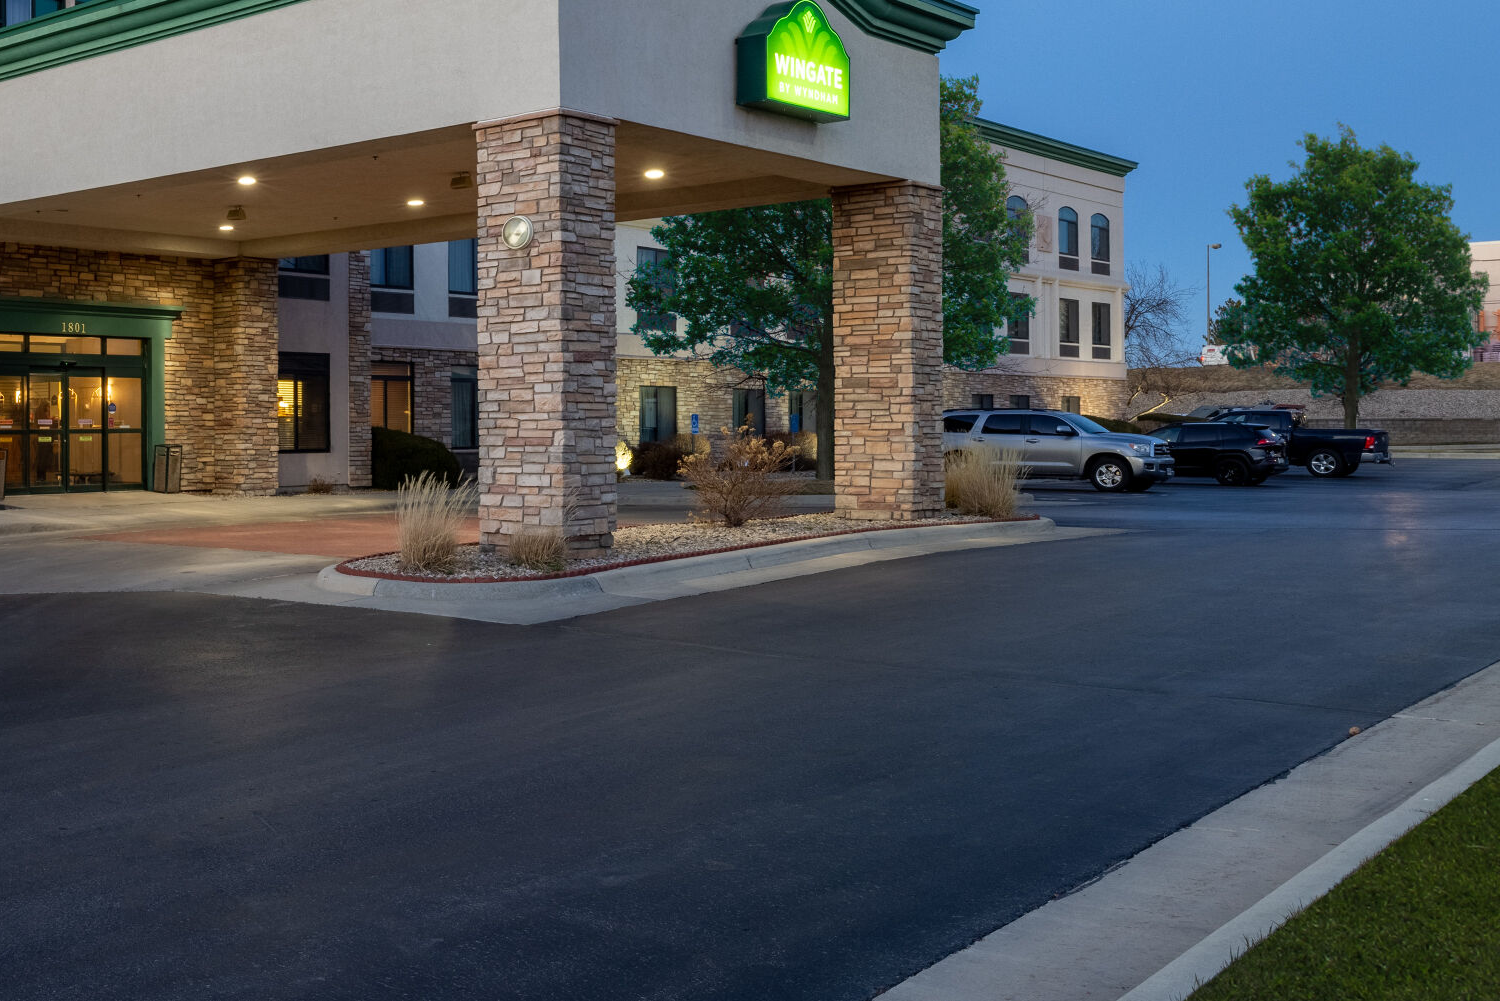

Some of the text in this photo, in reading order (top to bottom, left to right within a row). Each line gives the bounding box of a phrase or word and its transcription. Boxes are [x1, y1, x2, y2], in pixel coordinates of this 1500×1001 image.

[774, 52, 843, 90] WINGATE
[779, 81, 838, 105] BY WYNDHAM
[61, 322, 86, 334] 1801
